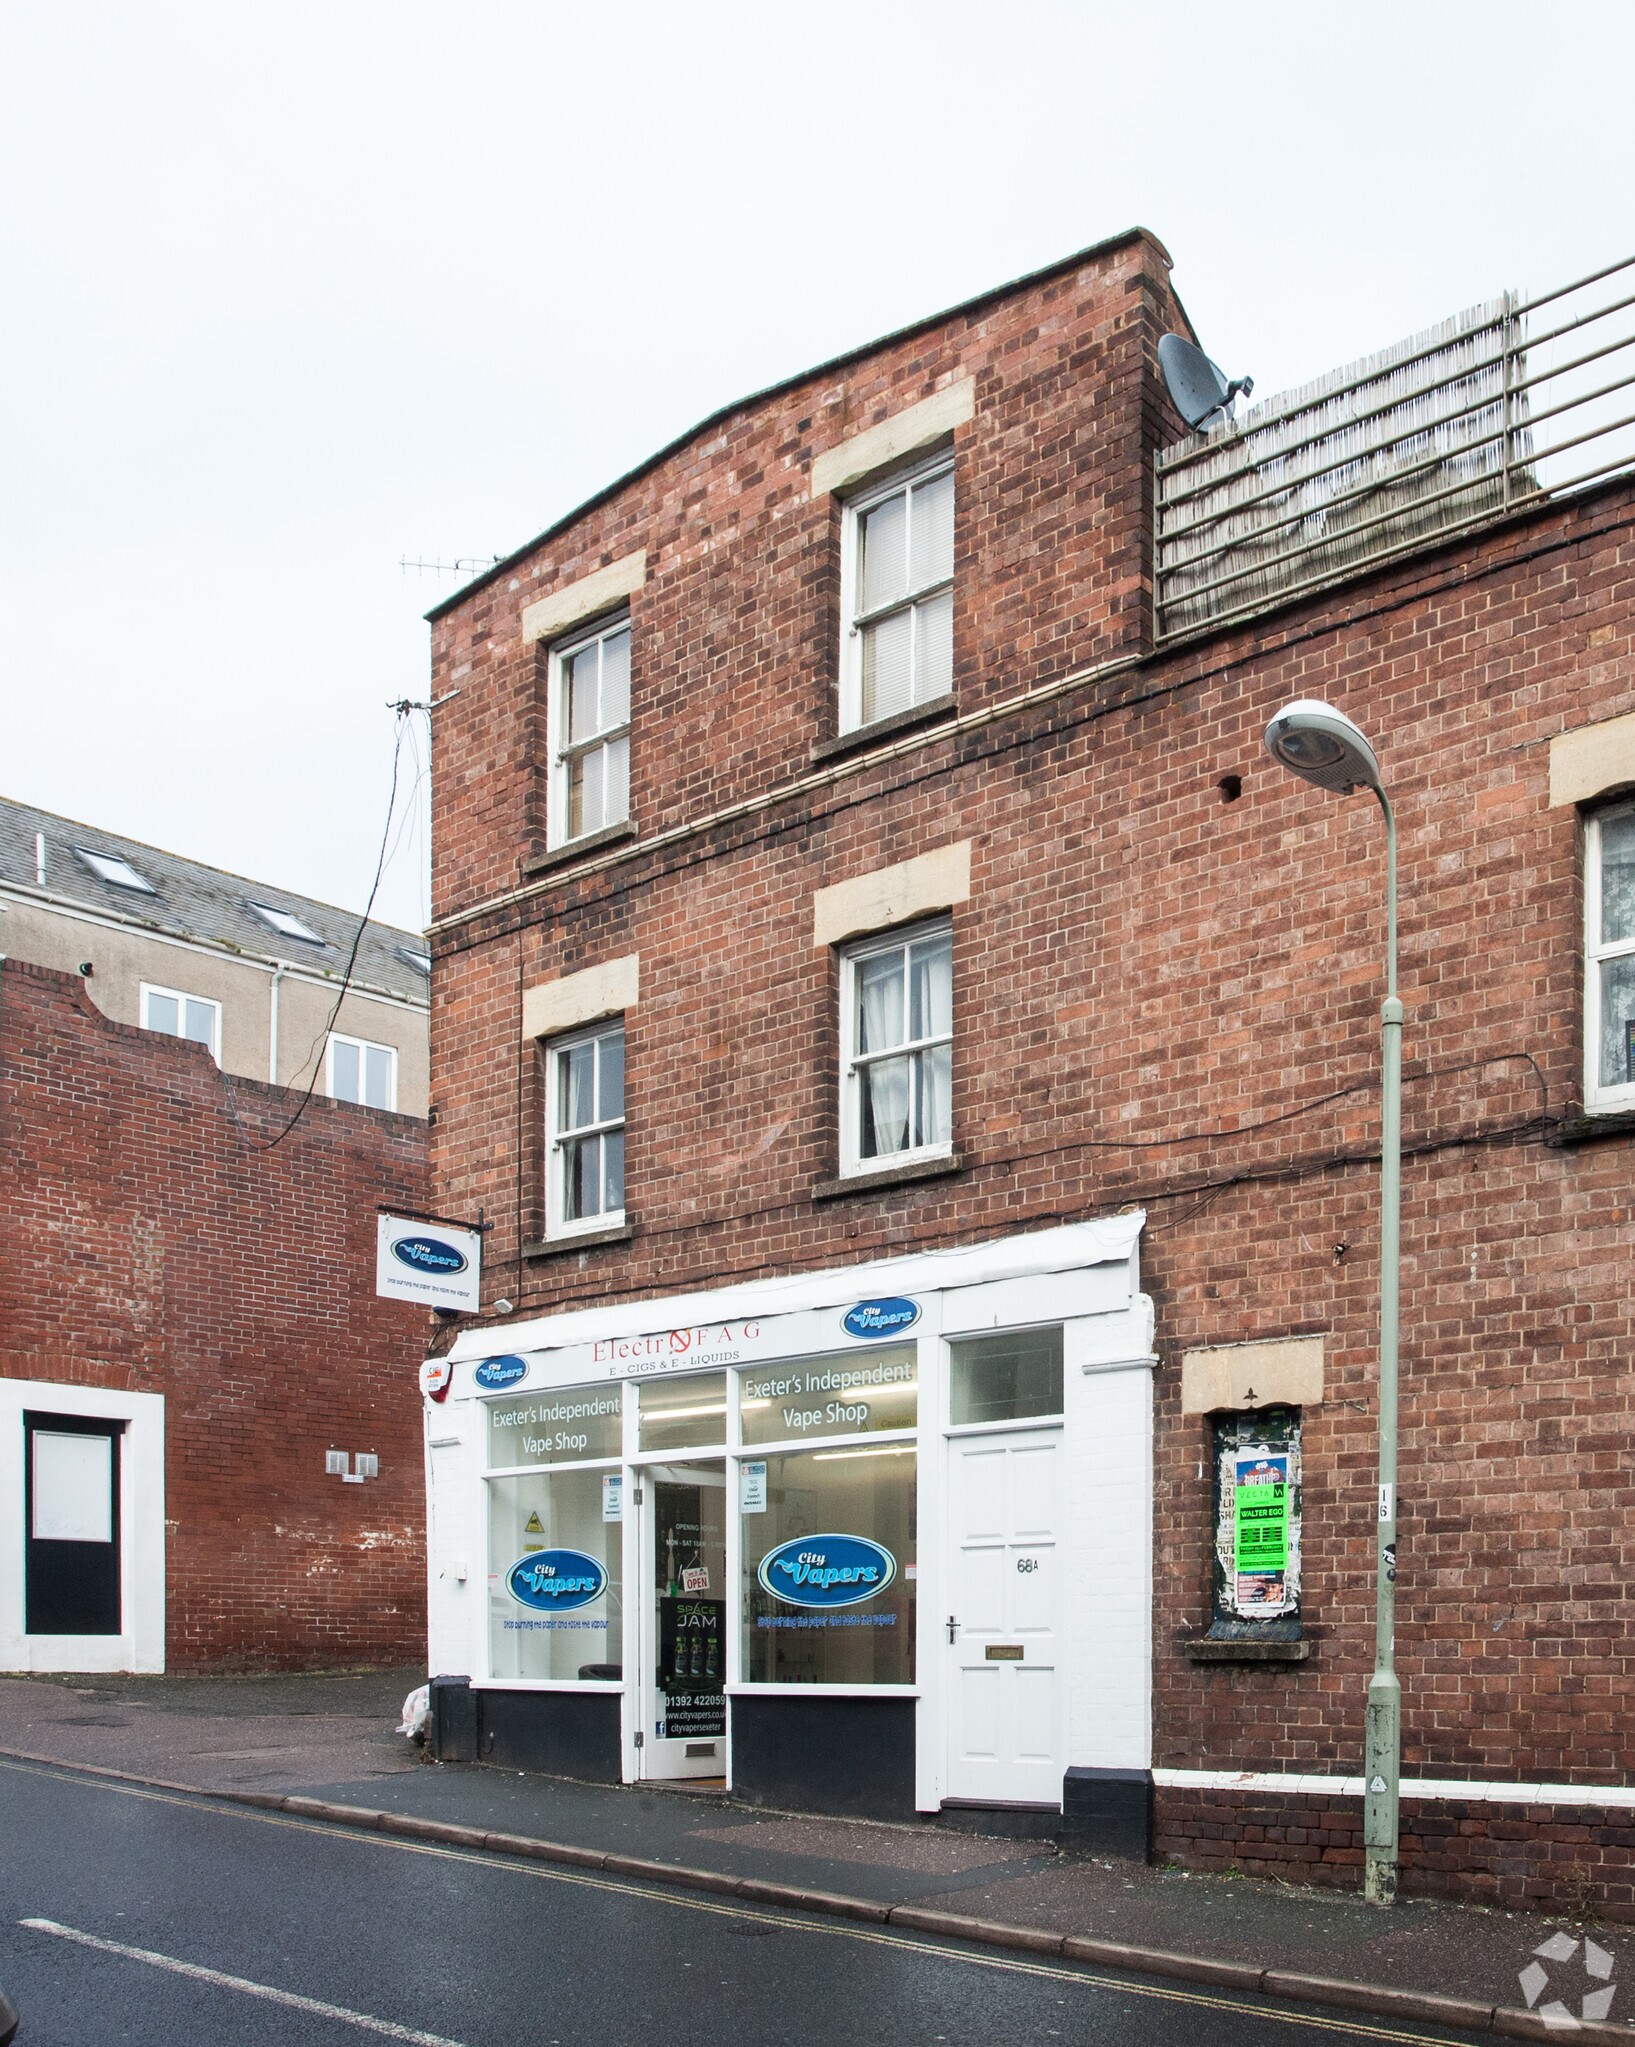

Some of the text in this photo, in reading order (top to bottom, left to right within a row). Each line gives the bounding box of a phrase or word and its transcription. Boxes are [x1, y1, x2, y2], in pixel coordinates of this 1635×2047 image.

[414, 1243, 431, 1253] City
[400, 1244, 459, 1267] Vapers
[863, 1307, 880, 1316] City
[848, 1311, 913, 1328] Vapers
[660, 1360, 667, 1369] &
[690, 1350, 740, 1365] LIQUIDS
[479, 1368, 523, 1382] Vapers
[745, 1362, 912, 1398] Exeter's Independent
[493, 1397, 620, 1428] Exeter's Independent
[784, 1402, 868, 1431] Vape Shop
[522, 1432, 587, 1456] Vape Shop
[1241, 1508, 1283, 1518] WALTER EGO
[676, 1523, 700, 1532] OPENING
[798, 1552, 826, 1566] City
[1017, 1558, 1038, 1573] 68A
[534, 1564, 556, 1576] City
[774, 1559, 878, 1588] Vapers
[516, 1570, 596, 1596] Vapers
[687, 1577, 707, 1589] OPEN
[676, 1604, 716, 1615] SPACE
[542, 1620, 557, 1629] paper
[676, 1615, 716, 1628] JAM
[664, 1695, 726, 1706] 01392 422059
[671, 1723, 721, 1734] cityvapersexeter
